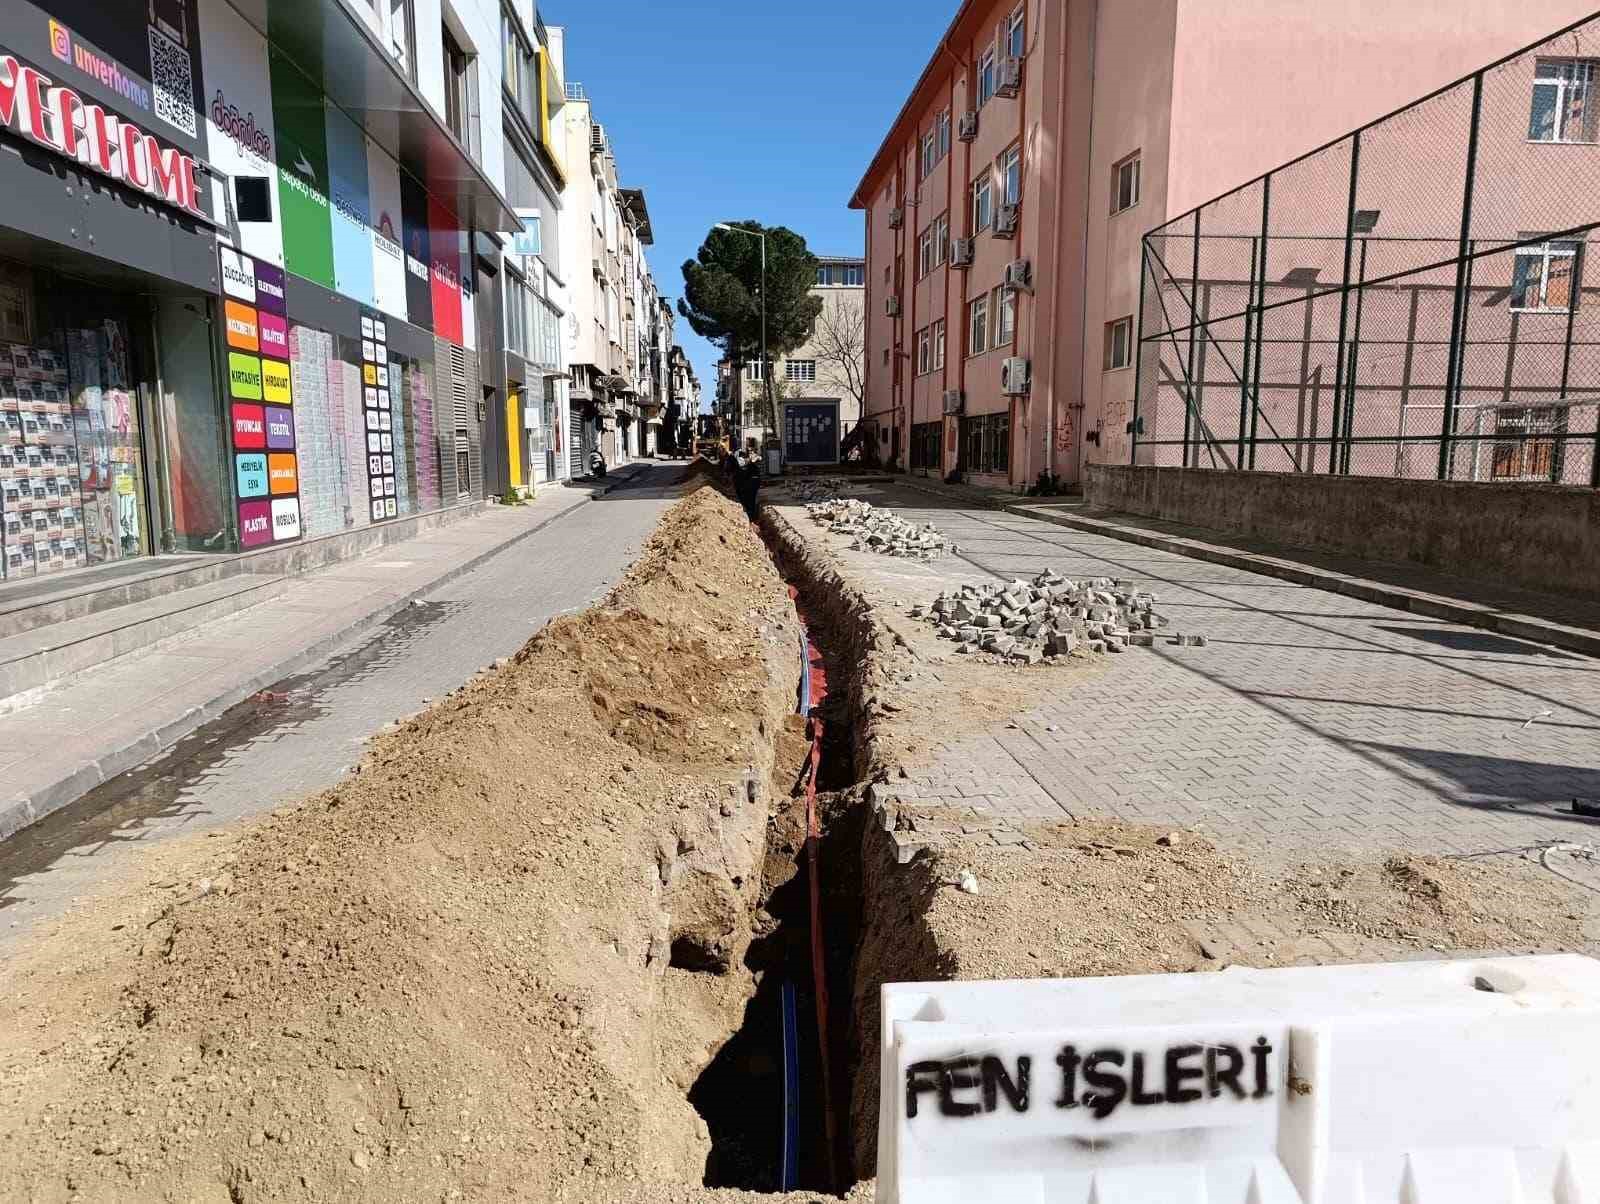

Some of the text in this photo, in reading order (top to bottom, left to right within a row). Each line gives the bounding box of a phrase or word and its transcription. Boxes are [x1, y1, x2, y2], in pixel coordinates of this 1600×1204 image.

[74, 43, 150, 110] unverhome
[265, 375, 288, 390] HIRDAVAT
[236, 419, 263, 433] OYUNCAK
[905, 1035, 1274, 1119] FEN İŞLERİ
